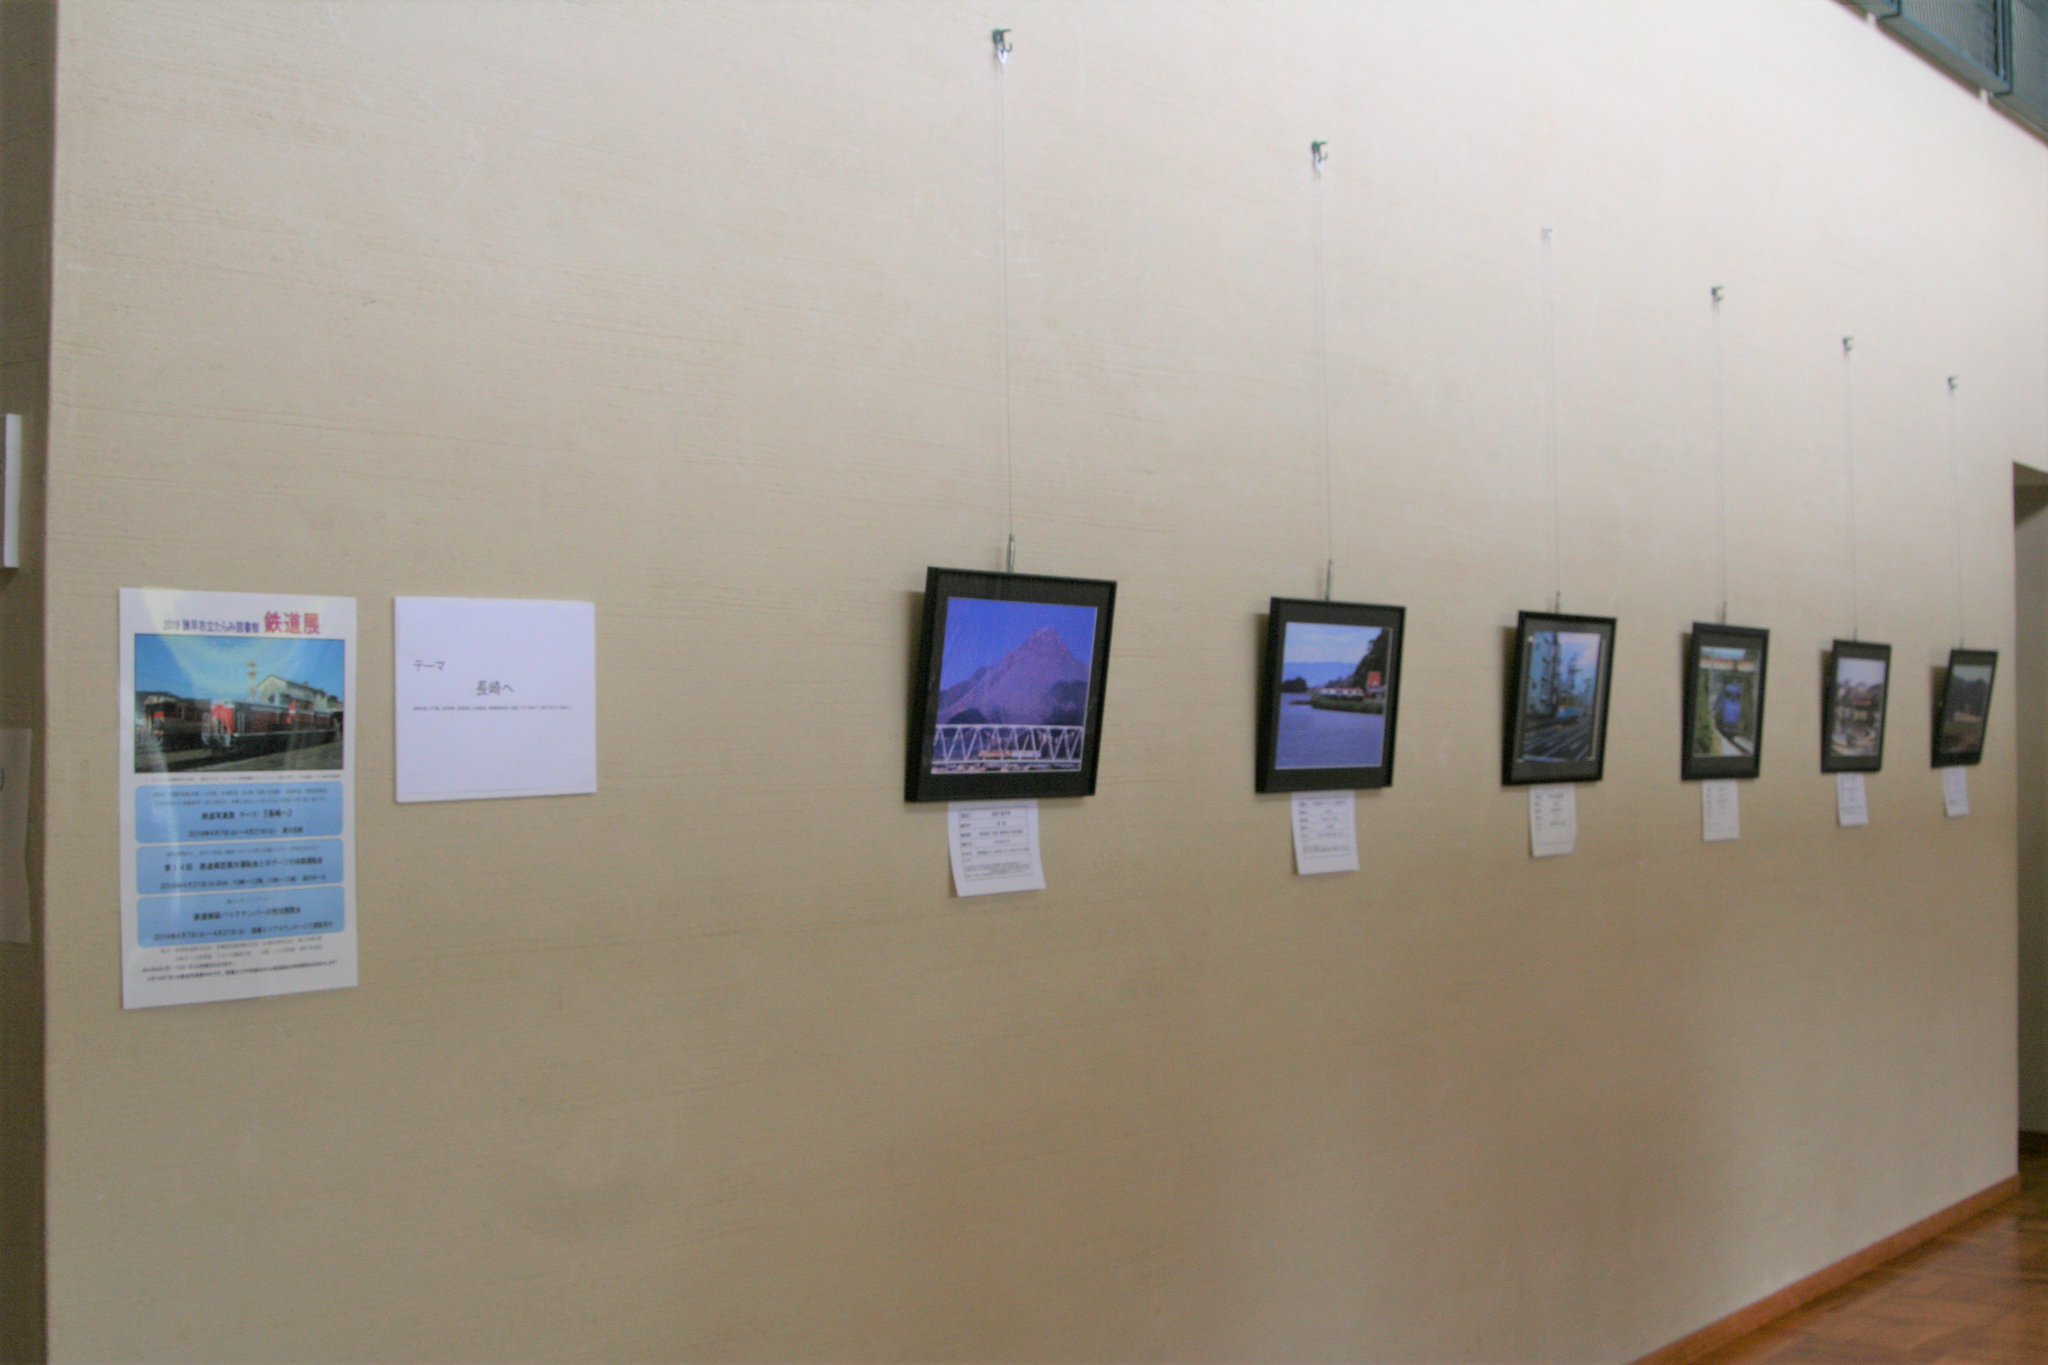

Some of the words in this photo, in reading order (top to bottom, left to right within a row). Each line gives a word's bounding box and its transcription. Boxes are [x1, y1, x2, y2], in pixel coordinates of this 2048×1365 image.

[263, 610, 321, 635] 鉄道展
[413, 659, 446, 672] テーマ
[476, 680, 515, 697] 長崎へ
